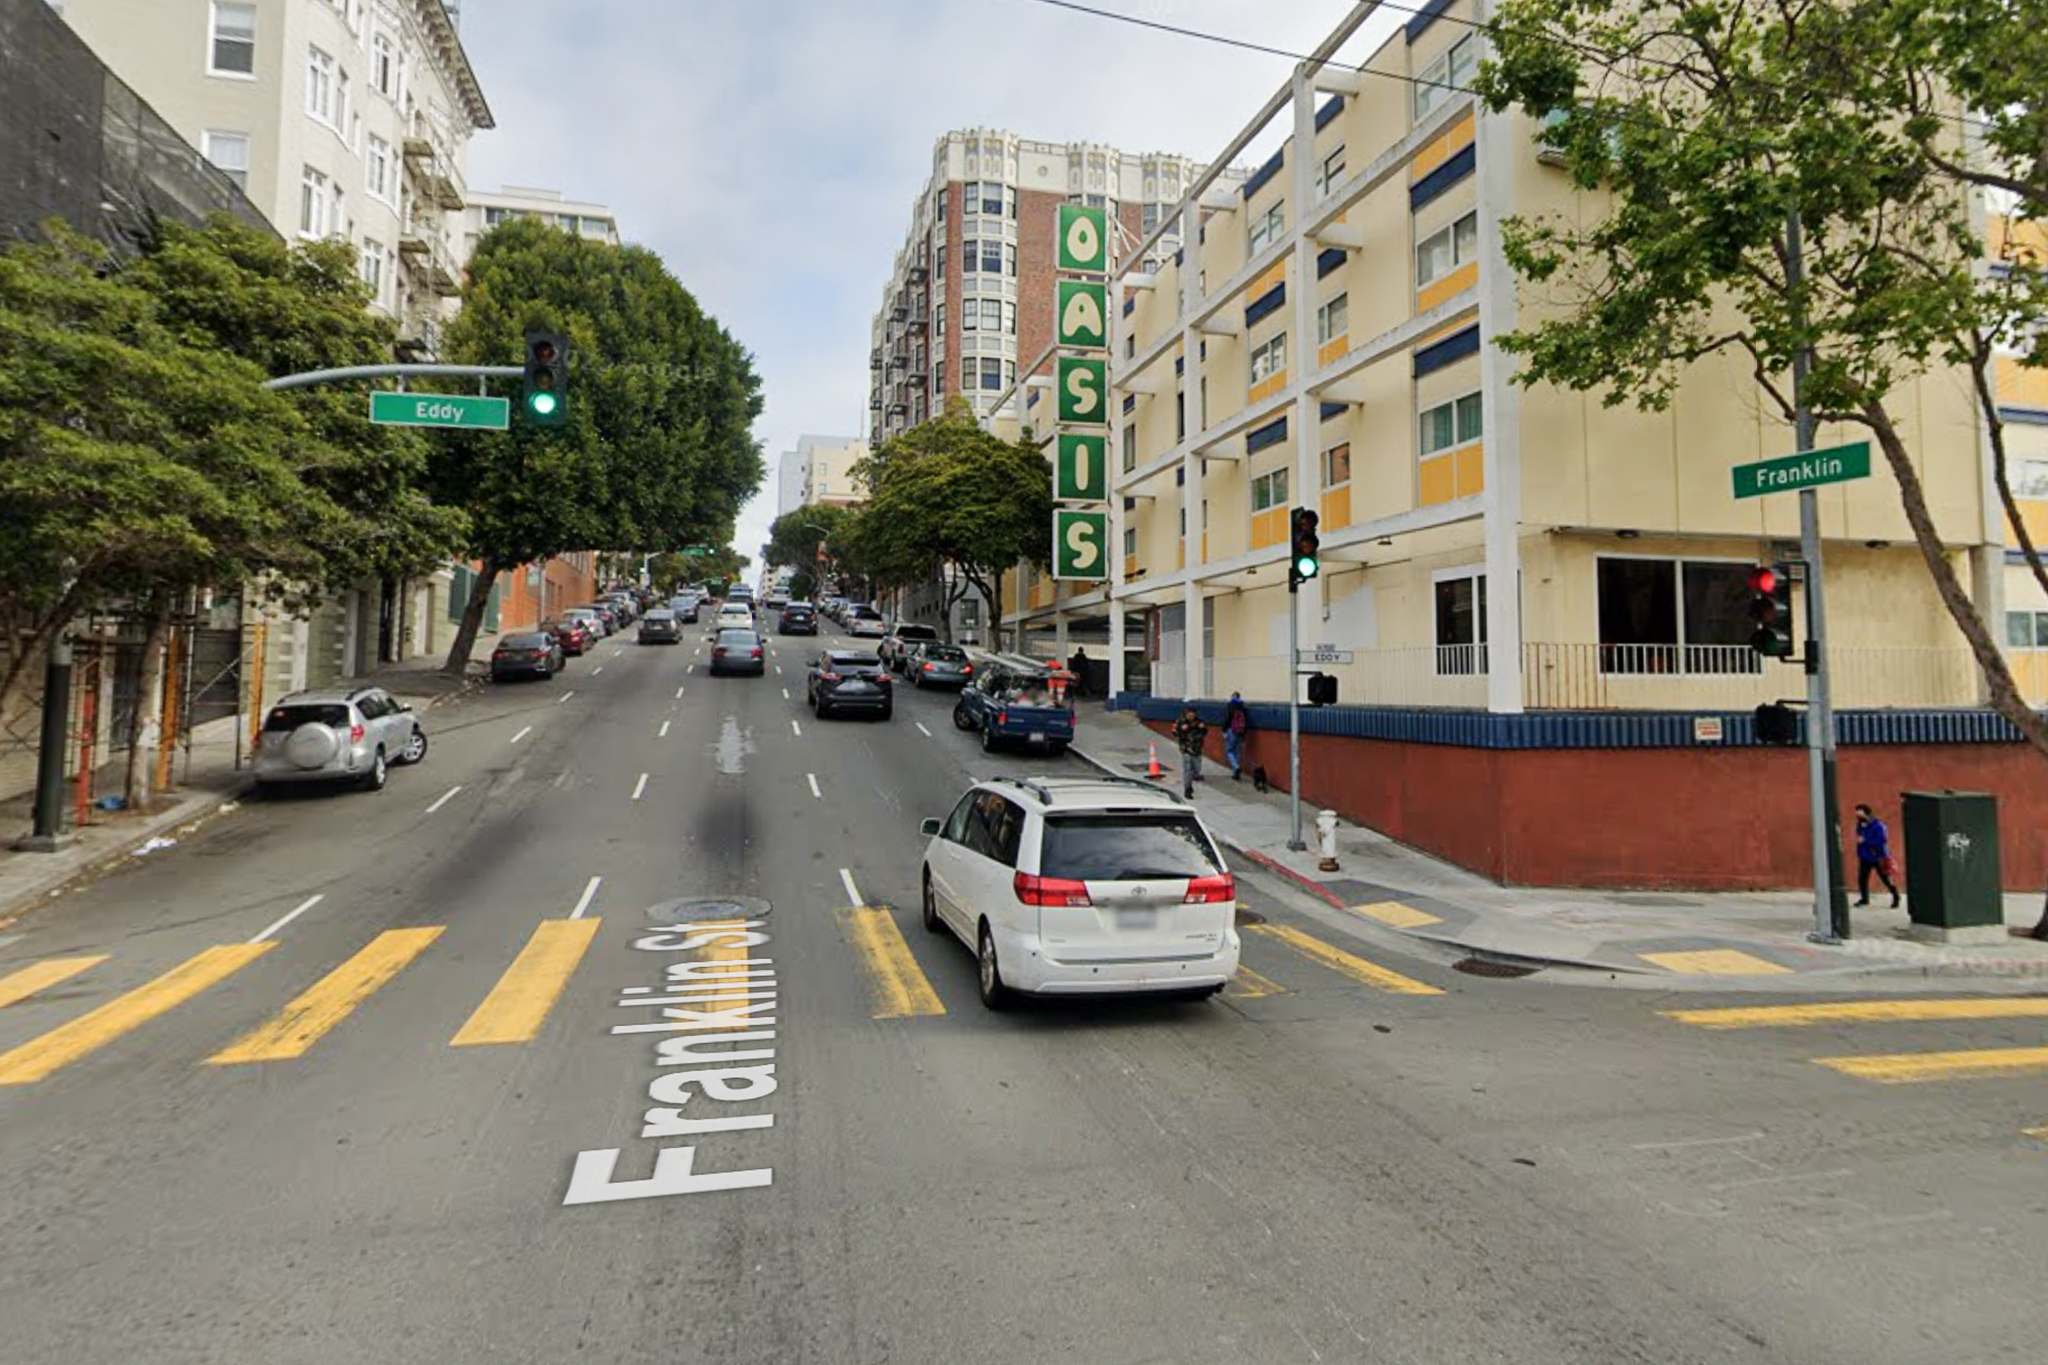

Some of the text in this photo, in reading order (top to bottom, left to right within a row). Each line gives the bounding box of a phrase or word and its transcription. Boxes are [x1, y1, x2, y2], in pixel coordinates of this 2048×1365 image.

[1061, 216, 1102, 568] OASIS
[416, 401, 464, 423] Eddy
[1756, 457, 1842, 487] Franklin
